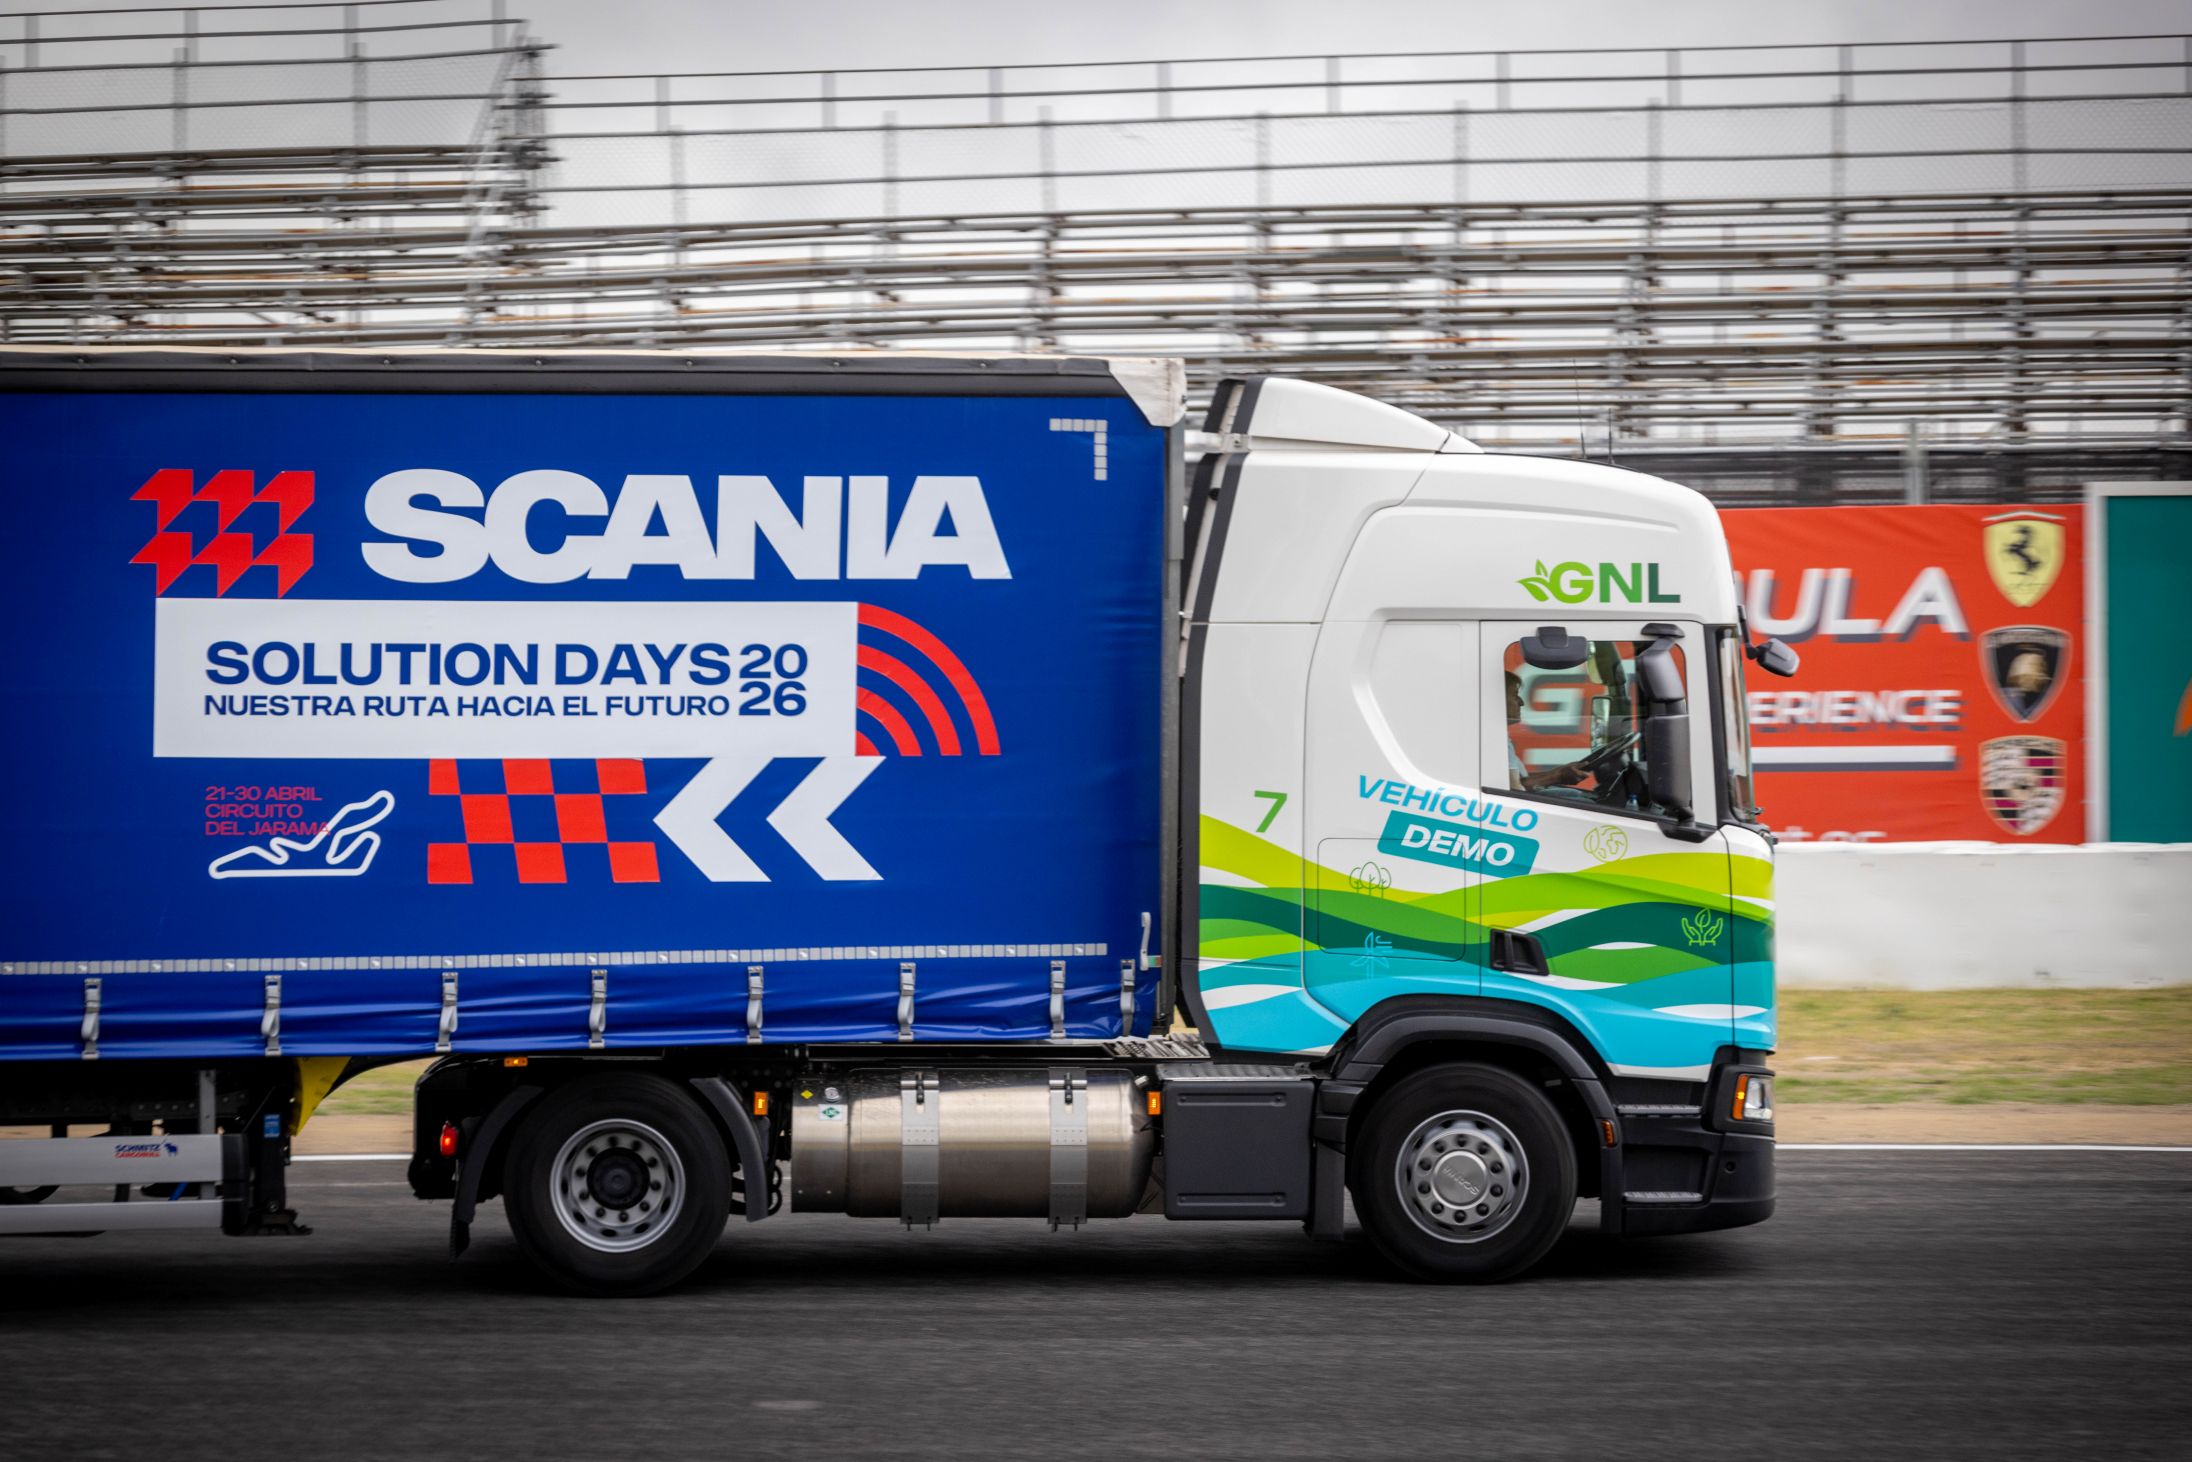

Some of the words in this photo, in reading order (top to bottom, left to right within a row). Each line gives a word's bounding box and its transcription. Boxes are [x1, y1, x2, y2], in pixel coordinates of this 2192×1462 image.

[361, 468, 1013, 584] SCANIA
[1549, 560, 1681, 605] GNL
[205, 640, 540, 687] SOLUTION
[554, 640, 732, 687] DAYS
[738, 643, 809, 680] 20
[204, 694, 356, 717] NUESTRA
[363, 694, 450, 717] RUTA
[457, 694, 556, 717] HACIA
[562, 694, 598, 717] EL
[605, 694, 730, 717] FUTURO
[738, 680, 808, 717] 26
[1747, 690, 1962, 727] ERIENCE
[205, 785, 262, 801] 21-30
[265, 785, 323, 801] ABRIL
[205, 803, 304, 819] CIRCUITO
[1359, 774, 1539, 832] VEHÍCULO
[205, 820, 245, 837] DEL
[248, 820, 331, 837] JARAMA
[1253, 790, 1288, 834] 7
[1401, 823, 1515, 867] DEMO
